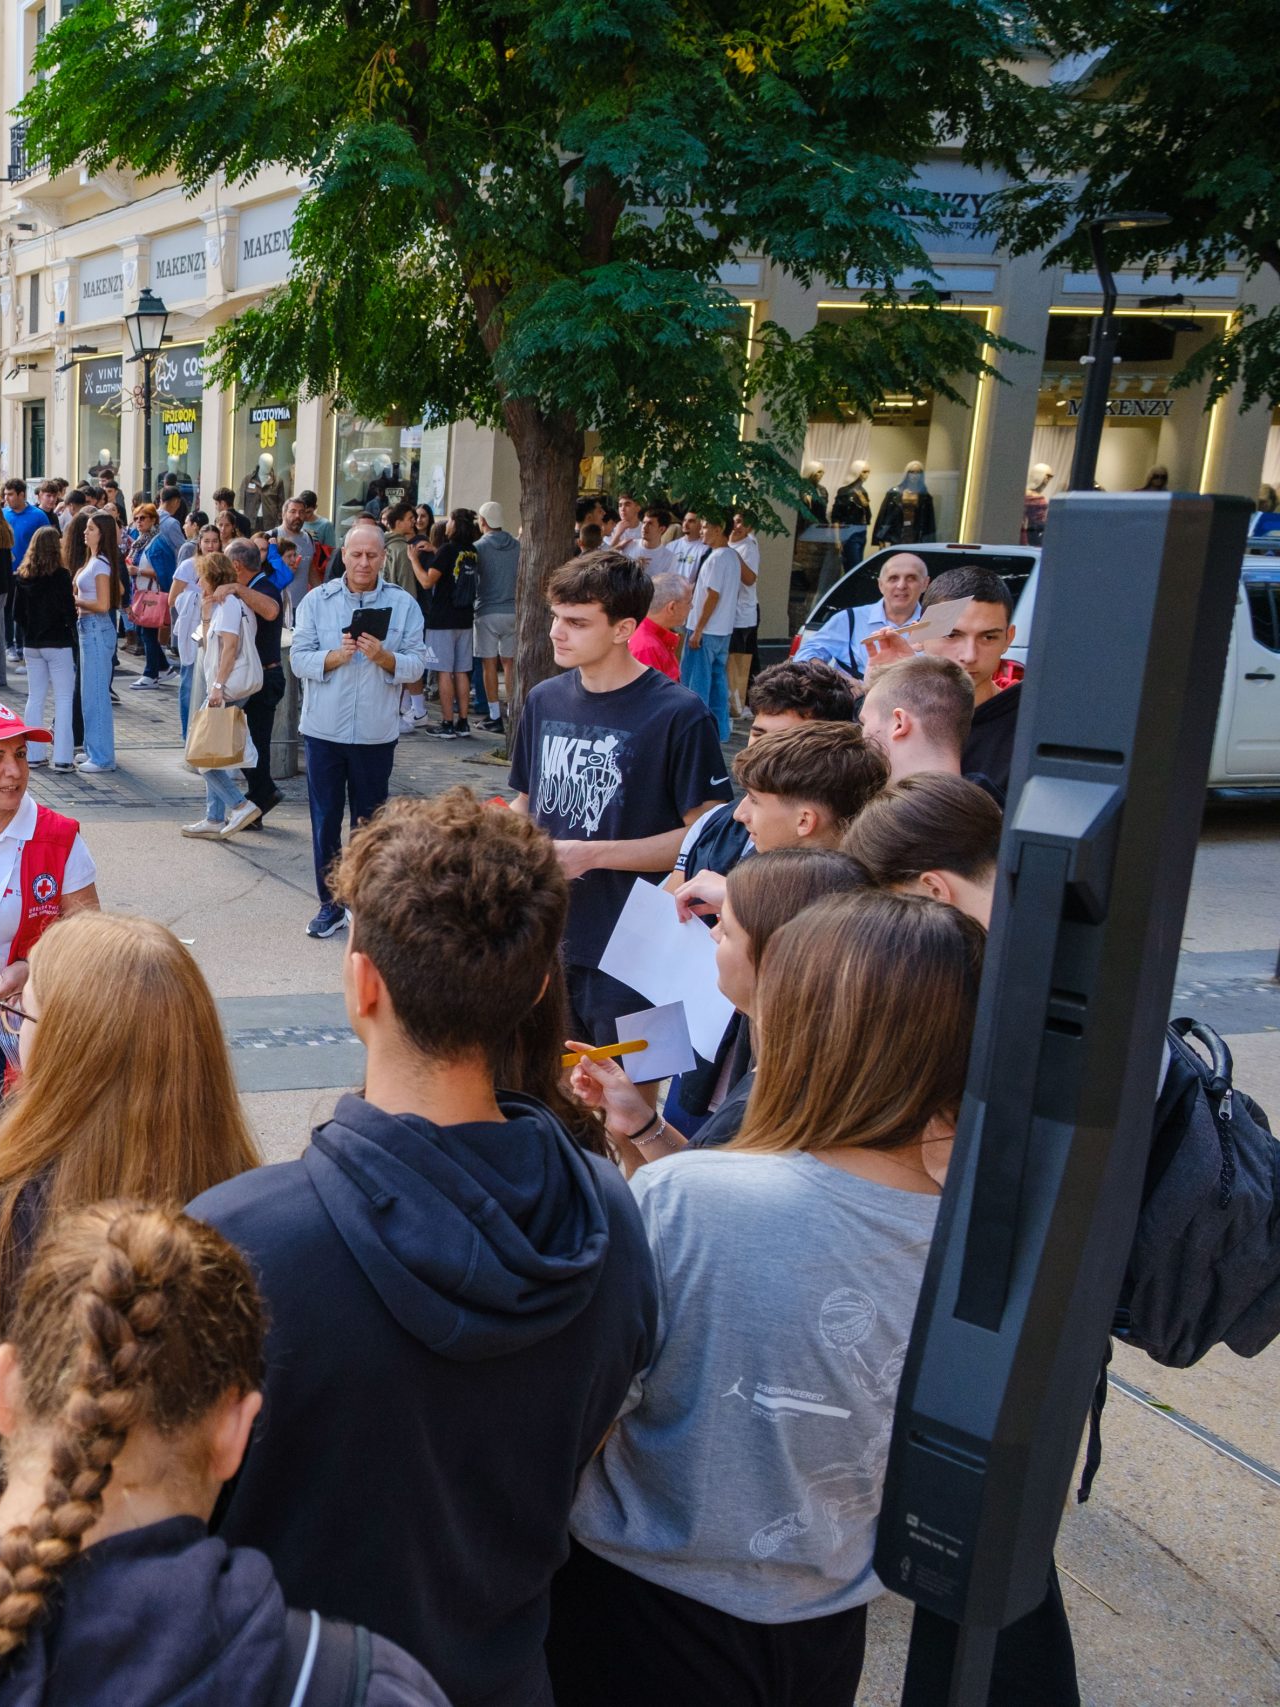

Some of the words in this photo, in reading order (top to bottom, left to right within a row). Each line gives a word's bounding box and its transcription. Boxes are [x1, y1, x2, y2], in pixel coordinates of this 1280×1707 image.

[156, 251, 206, 279] MAKENZY
[83, 274, 124, 299] MAKENZY
[98, 366, 123, 380] VINYL
[1066, 399, 1175, 417] MKENZY
[541, 735, 593, 782] NIKE
